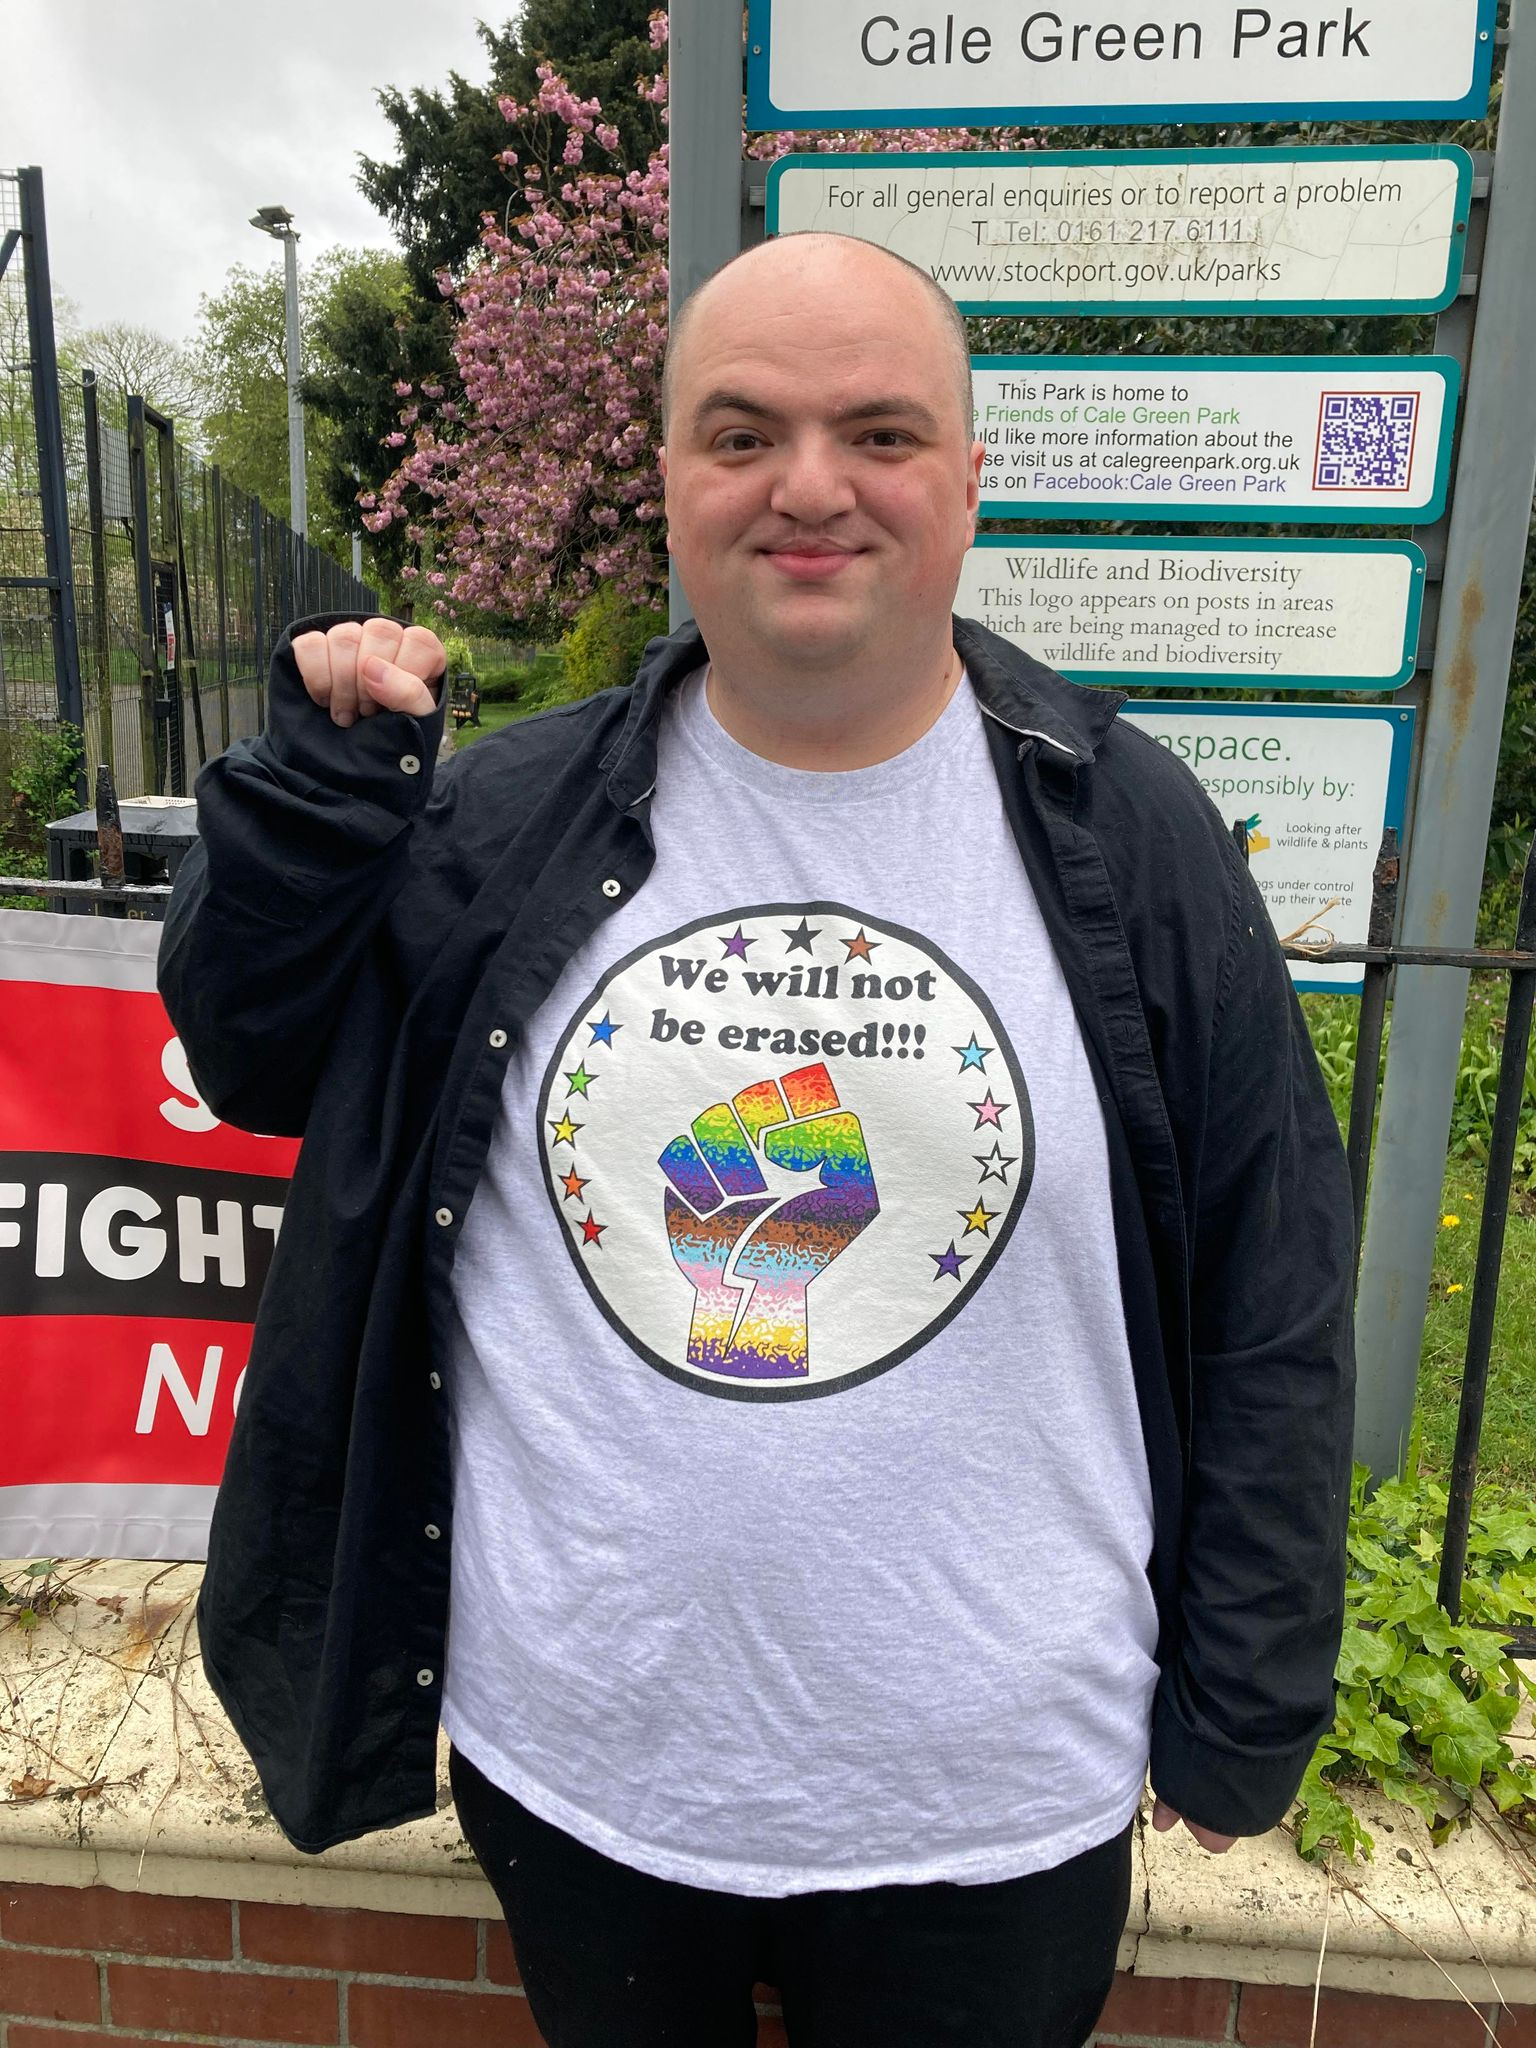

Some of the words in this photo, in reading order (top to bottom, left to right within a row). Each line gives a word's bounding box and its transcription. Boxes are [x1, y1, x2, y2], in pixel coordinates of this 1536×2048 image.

[860, 15, 993, 66] Cale
[1020, 11, 1203, 63] Green
[1232, 8, 1372, 60] Park
[827, 186, 863, 208] For
[873, 184, 899, 207] all
[906, 183, 995, 215] general
[1003, 181, 1112, 215] enquiries
[1120, 185, 1146, 205] or
[1155, 185, 1181, 205] to
[1188, 183, 1265, 211] report
[1274, 186, 1287, 203] a
[1296, 178, 1402, 210] problem
[971, 220, 987, 246] T
[1004, 221, 1047, 243] Tel:
[1057, 220, 1118, 242] 0161
[1130, 220, 1176, 242] 217
[1186, 218, 1244, 241] 6111
[931, 257, 1282, 290] www.stockport.gov.uk/parks
[998, 383, 1037, 400] This
[1043, 383, 1086, 401] Park
[1091, 384, 1107, 401] is
[1112, 384, 1165, 402] home
[1171, 386, 1189, 402] to
[986, 405, 1054, 422] Friends
[1060, 406, 1079, 423] of
[1084, 406, 1126, 423] Cale
[1132, 407, 1190, 424] Green
[1197, 408, 1240, 425] Park
[973, 428, 999, 445] uld
[1005, 428, 1036, 445] like
[1042, 431, 1089, 446] more
[1095, 429, 1198, 447] information
[1204, 431, 1258, 448] about
[1264, 432, 1293, 448] the
[983, 453, 1005, 467] se
[1011, 451, 1046, 467] visit
[1052, 454, 1073, 468] us
[1079, 452, 1097, 468] at
[1102, 452, 1300, 474] calegreenpark.org.uk
[979, 475, 999, 488] us
[1004, 475, 1027, 489] on
[1179, 475, 1236, 492] Green
[1243, 476, 1286, 493] Park
[1006, 557, 1098, 580] Wildlife
[1106, 559, 1149, 581] and
[1158, 559, 1303, 590] Biodiversity
[978, 588, 1023, 607] This
[1029, 588, 1073, 613] logo
[1080, 594, 1156, 614] appears
[1163, 595, 1189, 609] on
[1196, 595, 1249, 615] posts
[1255, 591, 1275, 610] in
[1282, 597, 1334, 611] areas
[982, 614, 1026, 633] hich
[1033, 621, 1063, 634] are
[1070, 615, 1125, 641] being
[1130, 617, 1220, 643] managed
[1227, 621, 1248, 637] to
[1254, 618, 1337, 639] increase
[1043, 642, 1116, 662] wildlife
[1122, 643, 1158, 663] and
[1166, 644, 1283, 671] biodiversity
[1155, 734, 1291, 768] nspace.
[1200, 775, 1315, 801] esponsibly
[1322, 776, 1355, 802] by:
[1277, 836, 1318, 849] wildlife
[1322, 839, 1330, 849] &
[1334, 838, 1368, 850] plants
[1286, 823, 1331, 837] Looking
[1335, 823, 1363, 836] after
[1257, 880, 1274, 892] ogs
[1277, 879, 1310, 890] under
[1313, 881, 1354, 892] control
[1271, 894, 1286, 907] up
[1290, 894, 1316, 906] their
[1318, 895, 1352, 906] wte
[659, 955, 728, 994] We
[741, 964, 839, 999] will
[850, 969, 937, 1001] not
[650, 1009, 706, 1046] be
[717, 1022, 927, 1060] erased!!!
